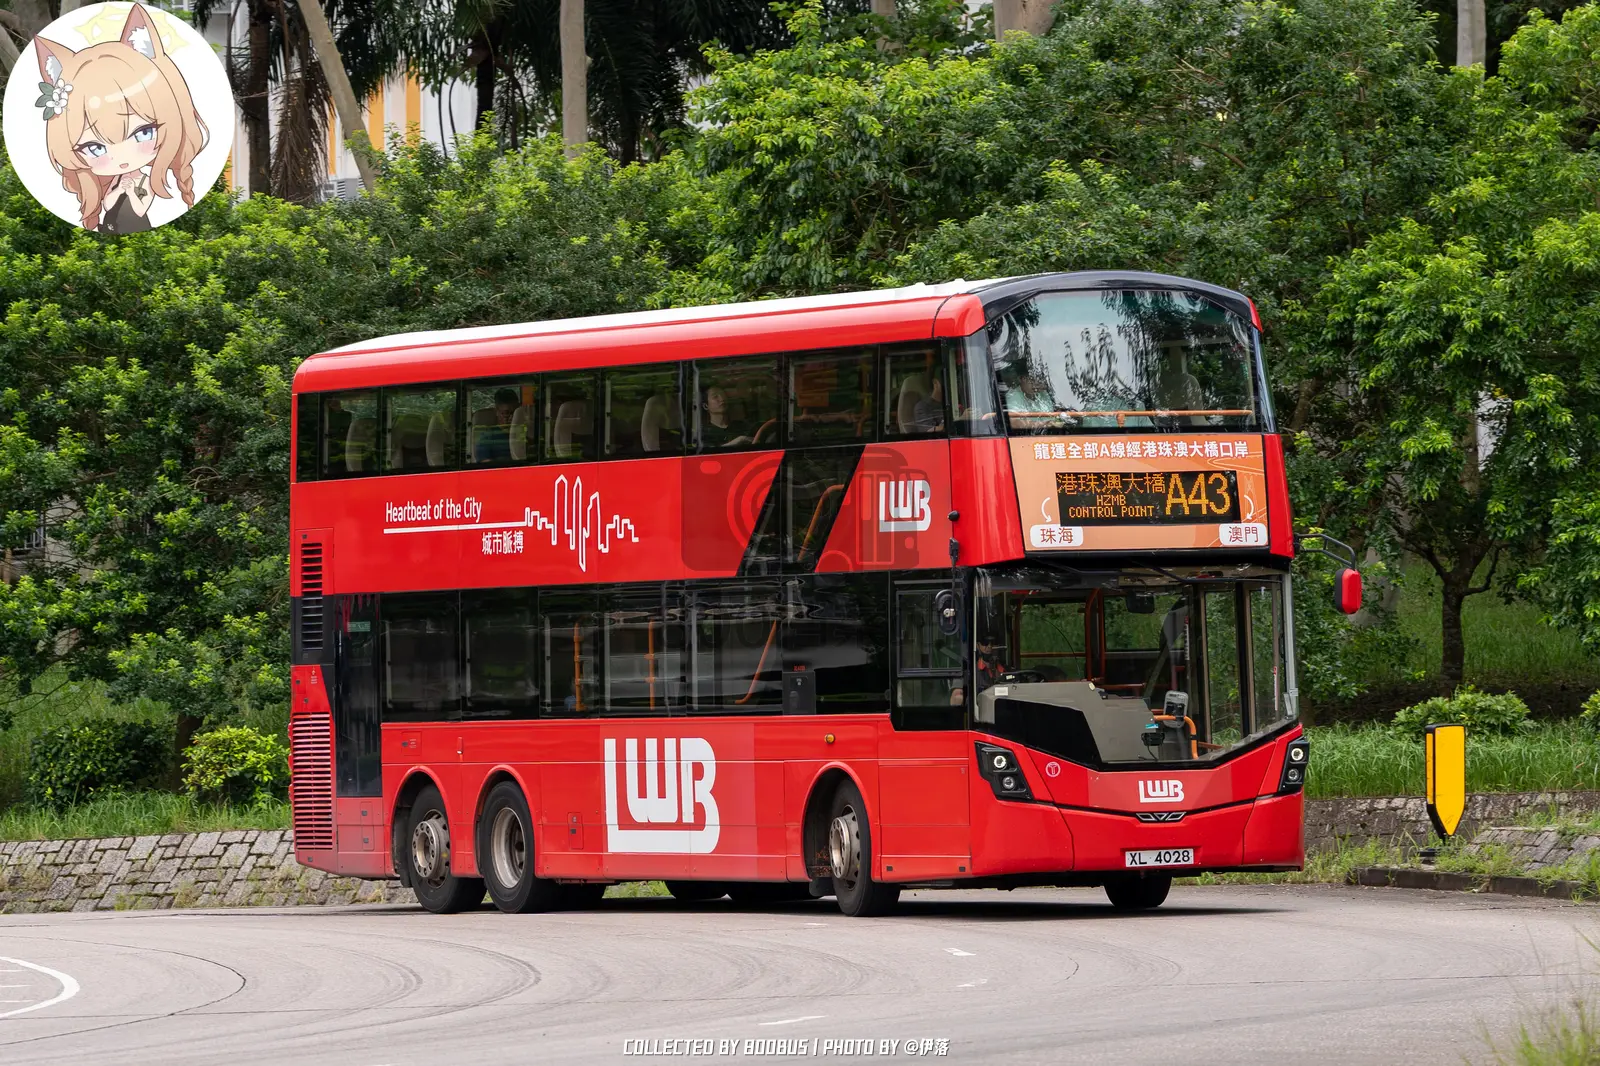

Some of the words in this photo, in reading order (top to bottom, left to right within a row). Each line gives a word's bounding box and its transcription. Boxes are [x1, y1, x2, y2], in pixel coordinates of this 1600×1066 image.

[1033, 441, 1249, 460] 龍運全部A線經港珠澳大橋口岸
[1057, 472, 1166, 495] 港珠澳大橋
[1165, 473, 1231, 515] A43
[385, 500, 432, 522] Heartbeat
[433, 499, 443, 519] of
[446, 499, 461, 518] the
[463, 497, 482, 523] City
[879, 480, 931, 533] LWB
[1068, 506, 1118, 518] CONTROL
[1121, 505, 1155, 517] POINT
[1096, 495, 1127, 506] HZMB
[482, 530, 524, 555] 城市脈搏
[1040, 528, 1074, 545] 珠海
[1228, 526, 1259, 544] 澳門
[604, 737, 721, 854] LWB
[1138, 780, 1185, 803] LWB
[1129, 852, 1148, 866] XL
[1154, 850, 1191, 864] 4028
